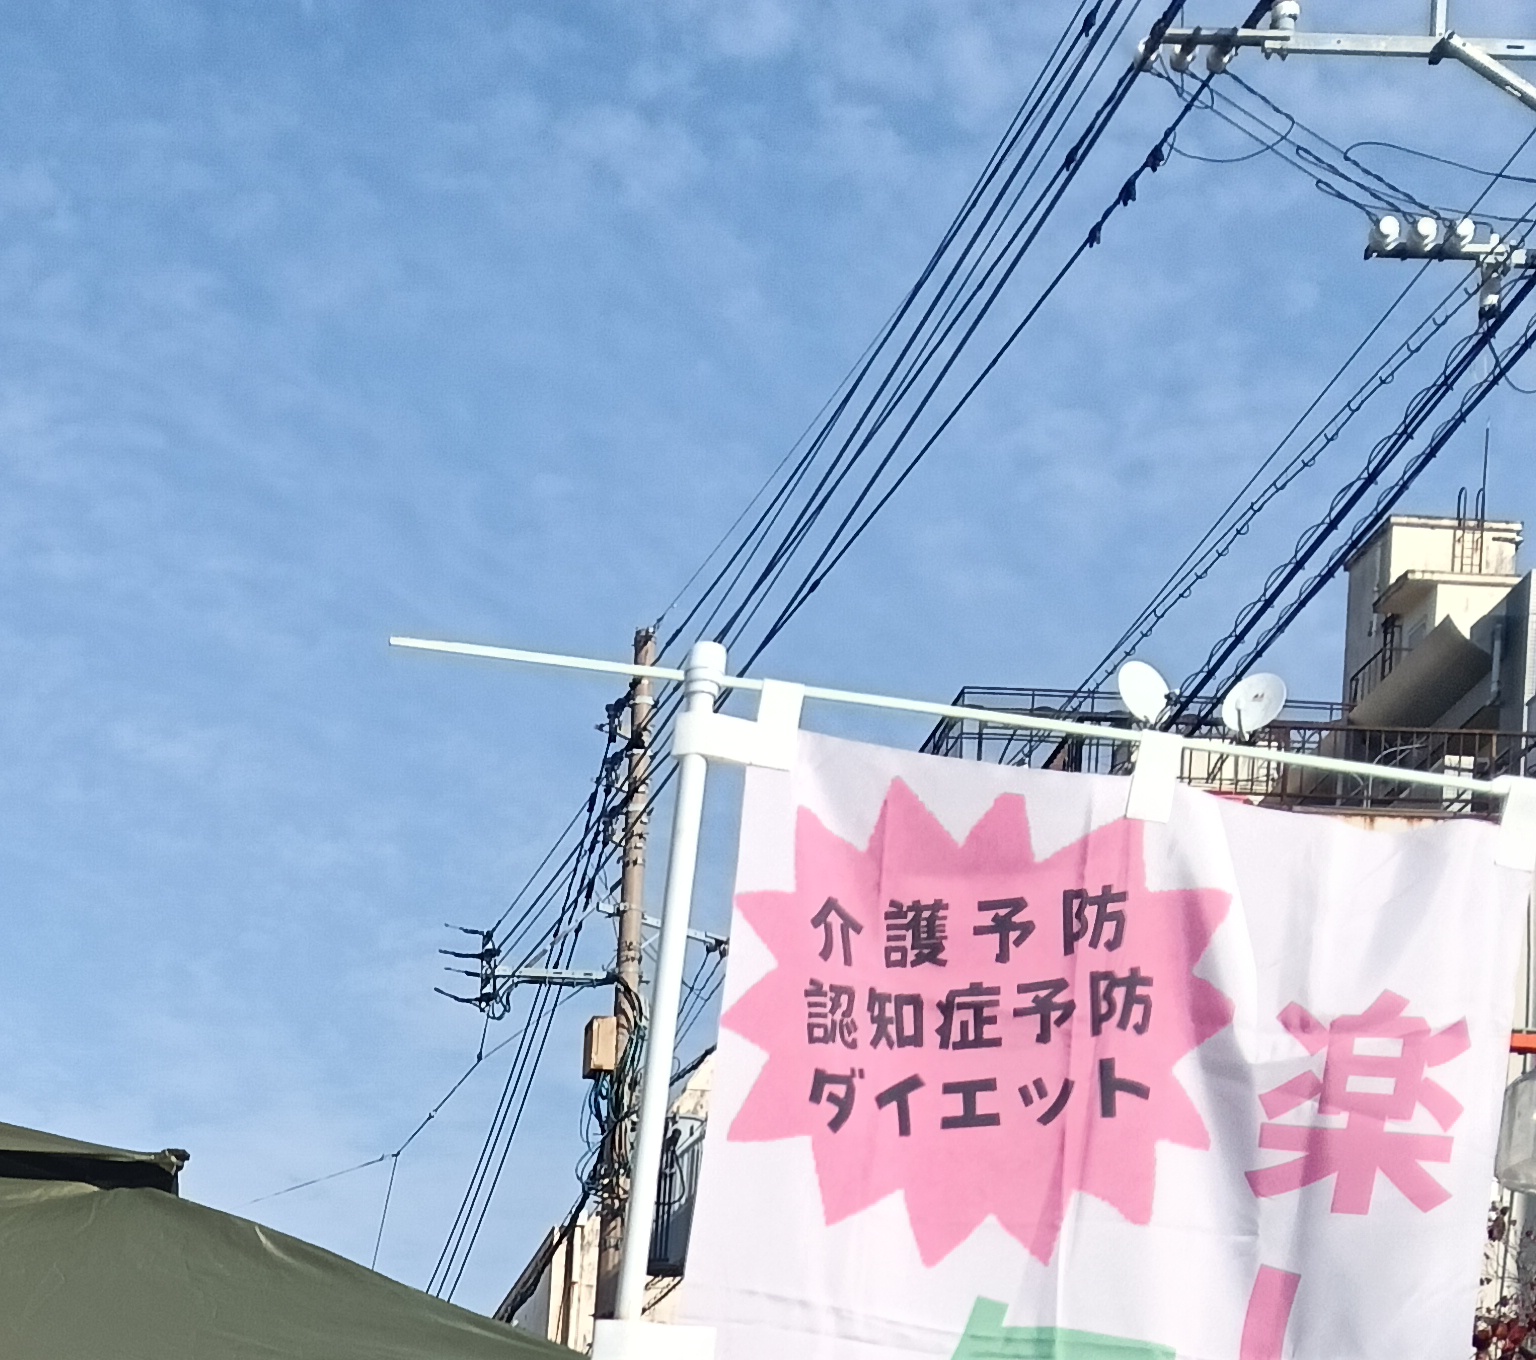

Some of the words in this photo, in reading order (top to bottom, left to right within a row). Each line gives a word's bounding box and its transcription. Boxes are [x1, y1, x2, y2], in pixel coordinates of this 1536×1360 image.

[810, 884, 1128, 968] 介護予防
[804, 966, 1153, 1050] 認知症予防
[808, 1057, 1150, 1137] ダイエット
